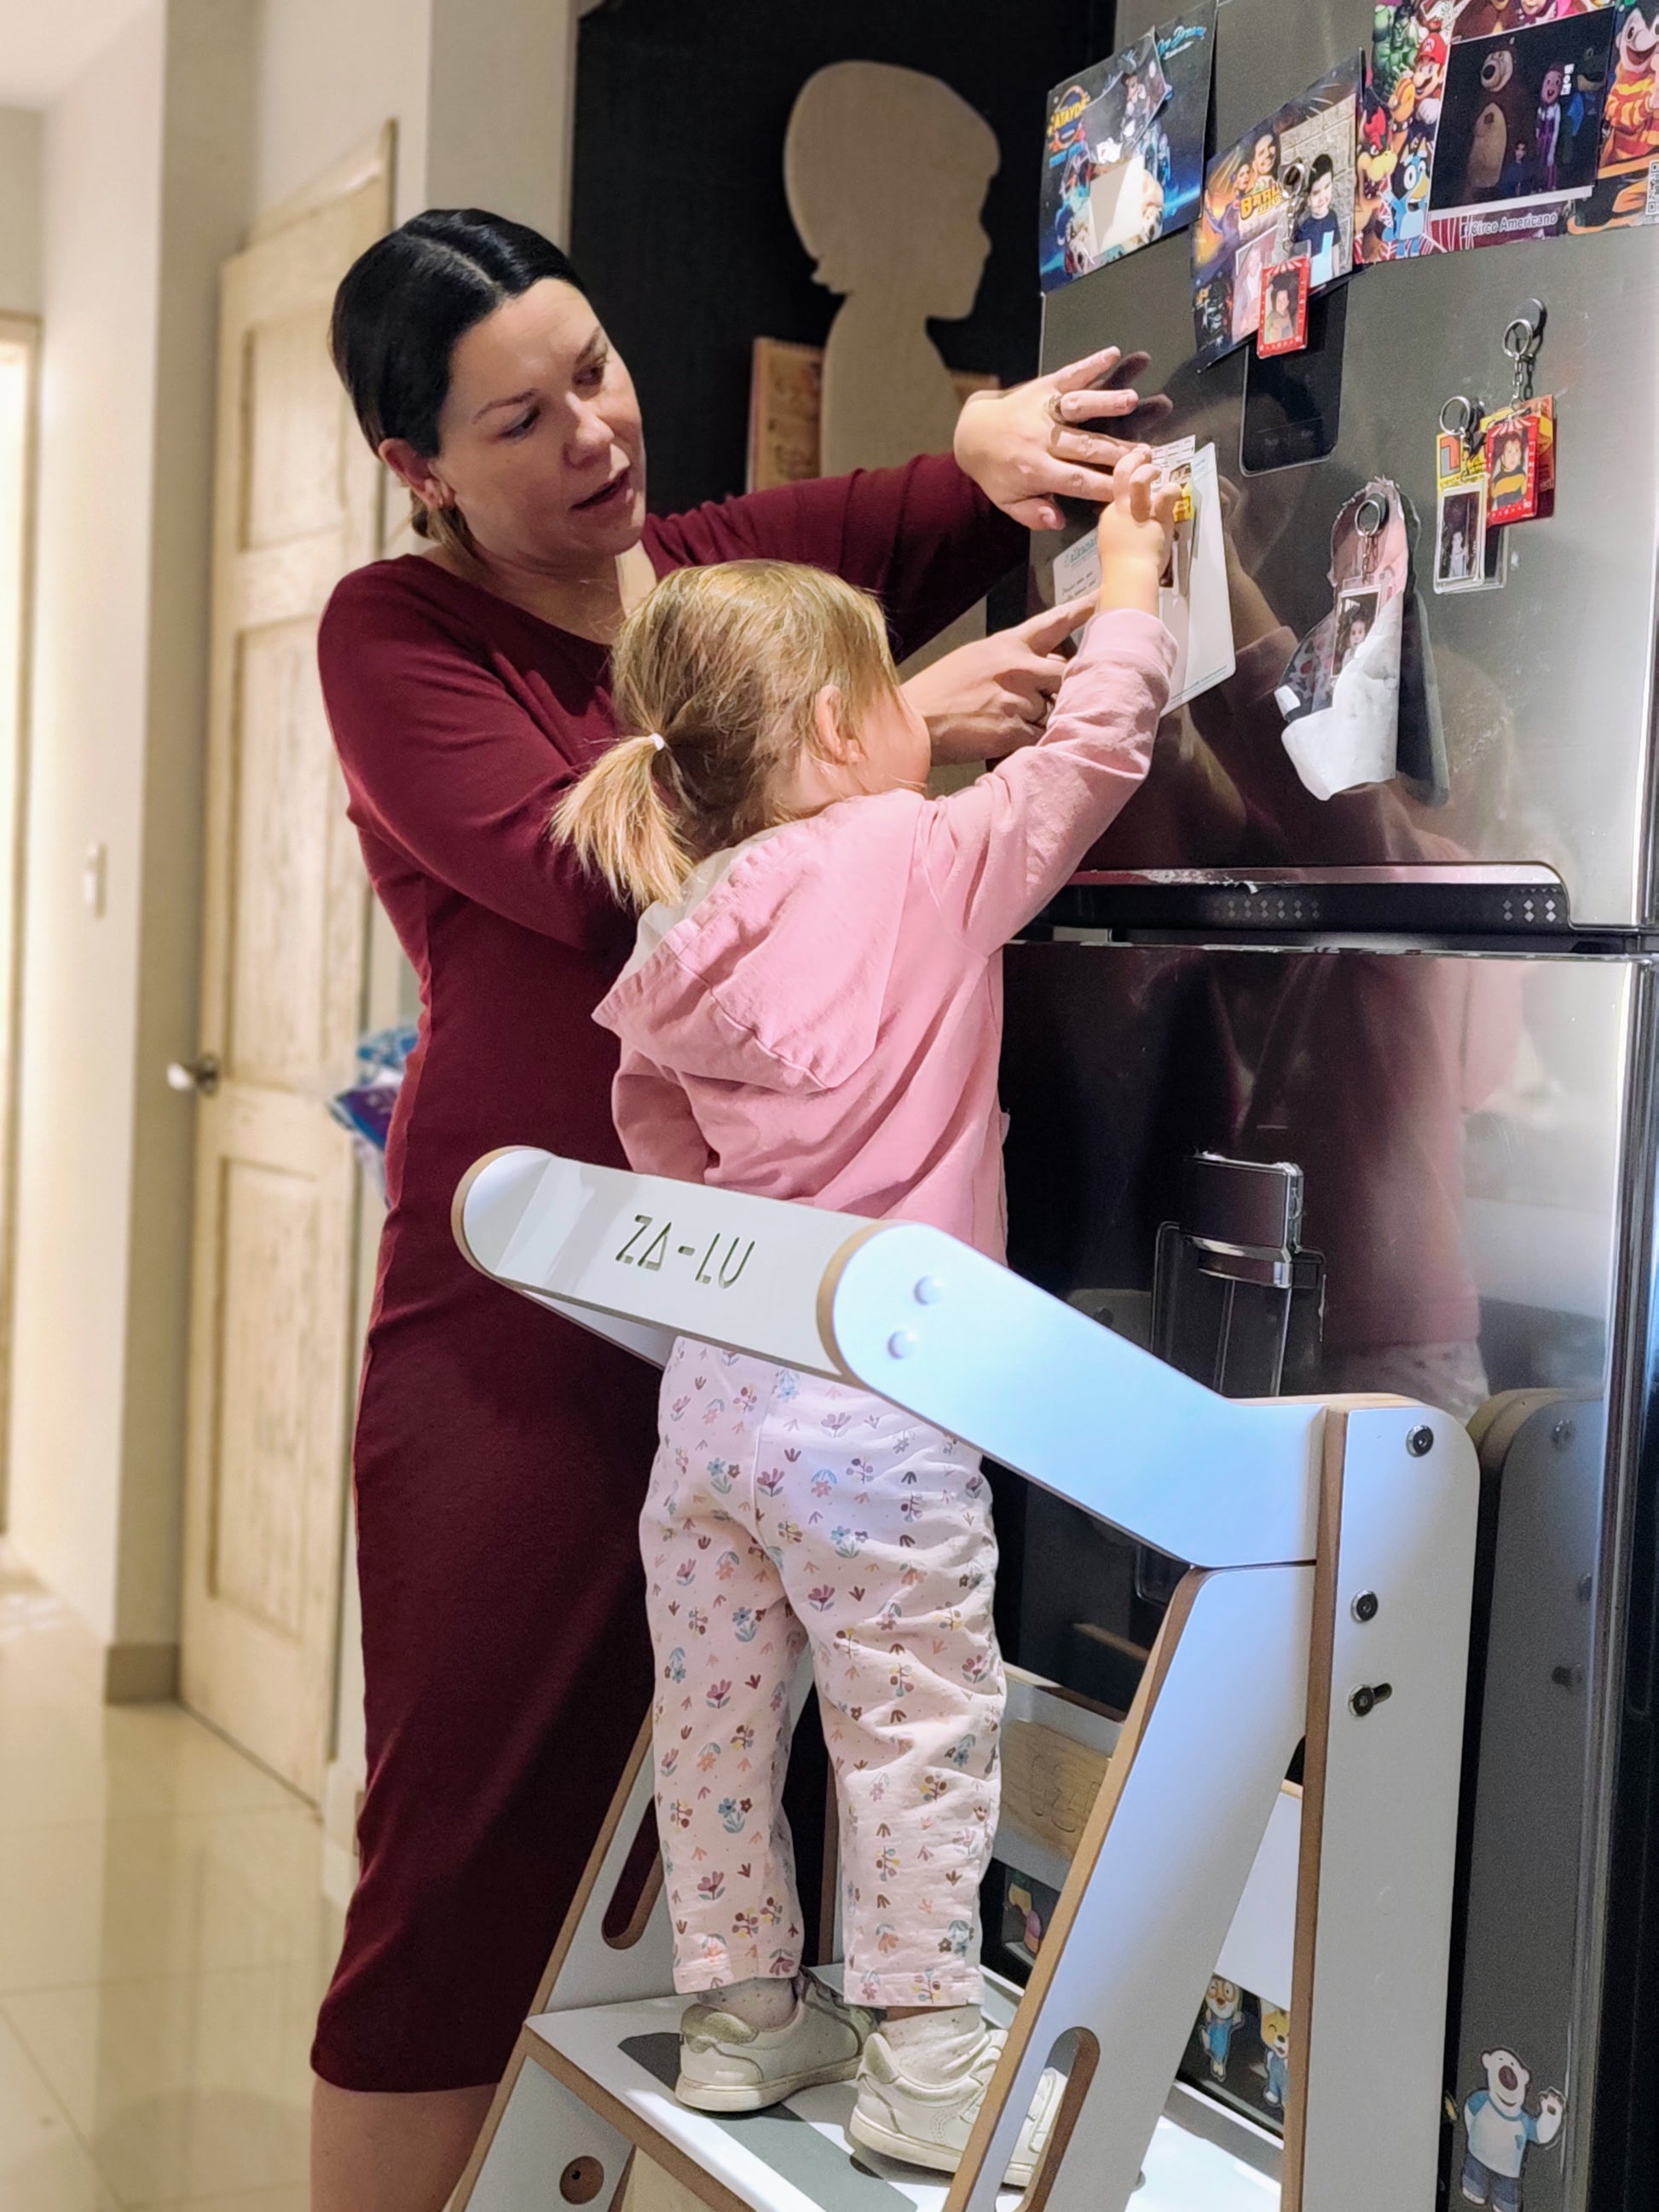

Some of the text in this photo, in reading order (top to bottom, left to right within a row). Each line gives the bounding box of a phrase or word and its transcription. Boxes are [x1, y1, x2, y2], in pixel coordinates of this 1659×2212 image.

[1471, 212, 1558, 235] Circo Americano
[615, 1213, 756, 1290] ZA-LU
